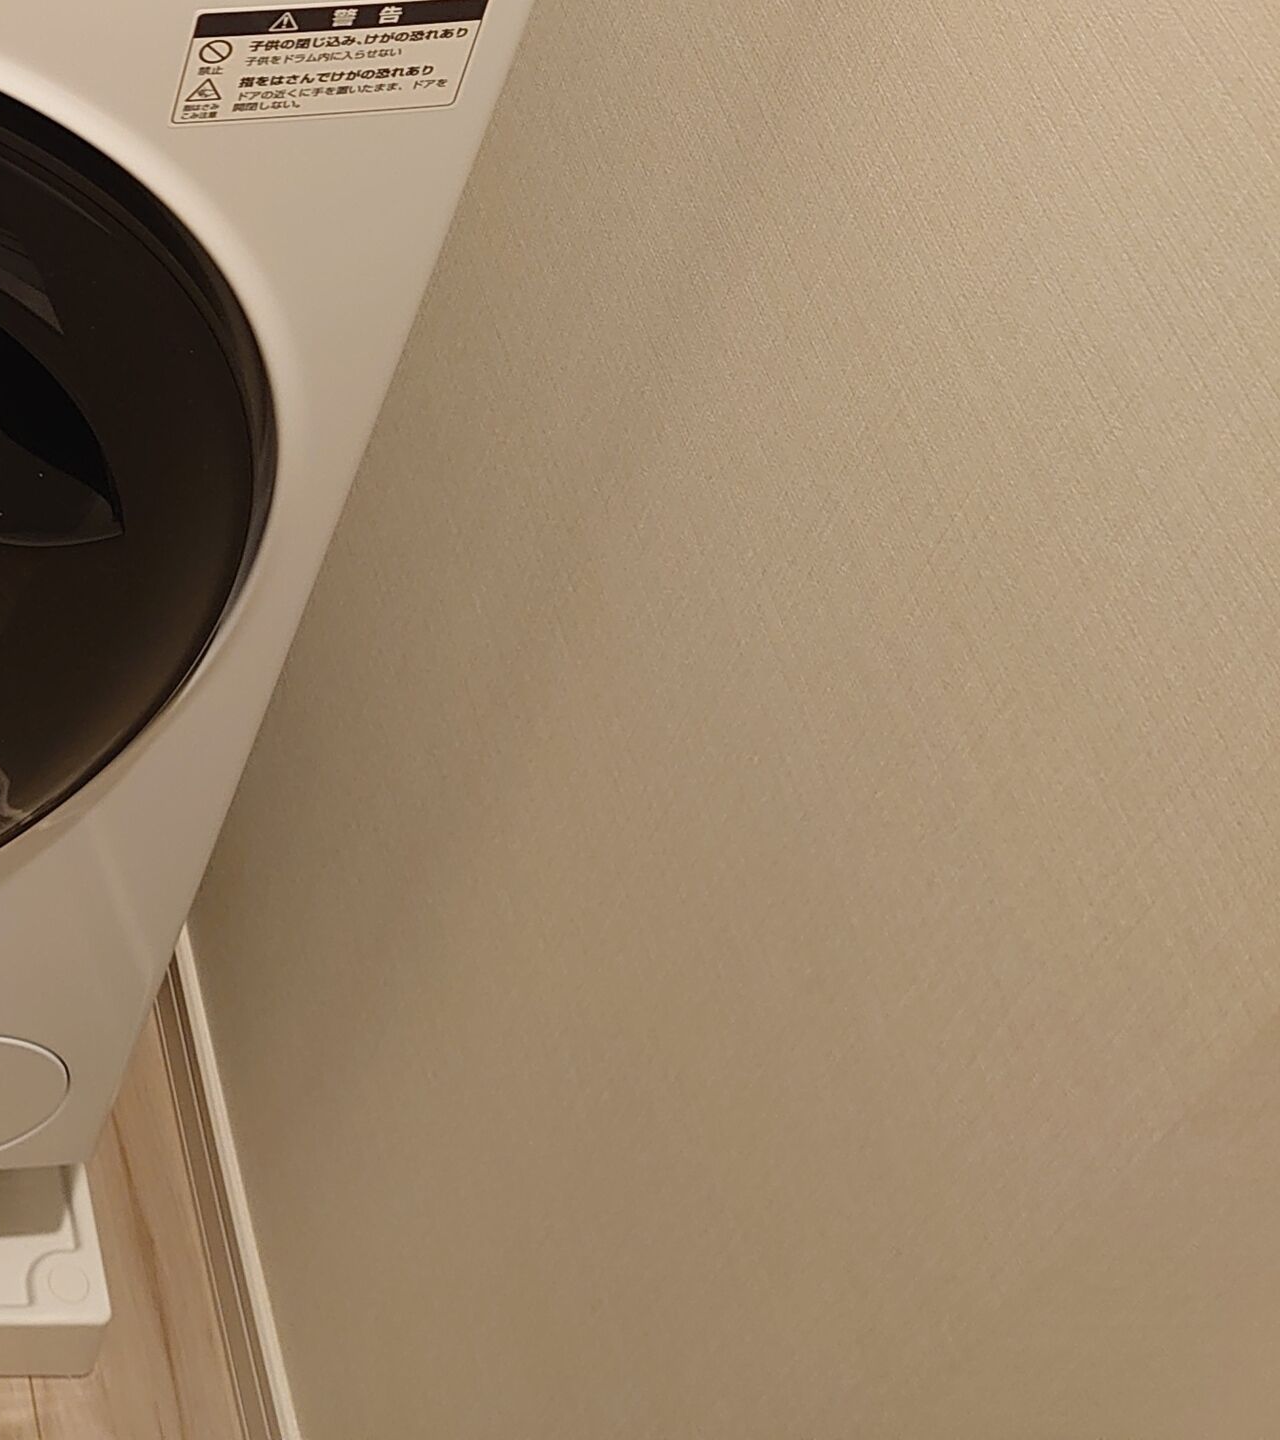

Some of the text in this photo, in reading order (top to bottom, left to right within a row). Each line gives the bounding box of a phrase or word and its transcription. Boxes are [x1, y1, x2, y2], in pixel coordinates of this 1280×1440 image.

[331, 6, 403, 28] 警告
[244, 47, 403, 67] 子供をドラム内に入らせない
[197, 65, 225, 77] 禁止
[237, 64, 435, 89] 指をはさんでけがの恐れあり
[231, 99, 303, 112] 開閉しない。
